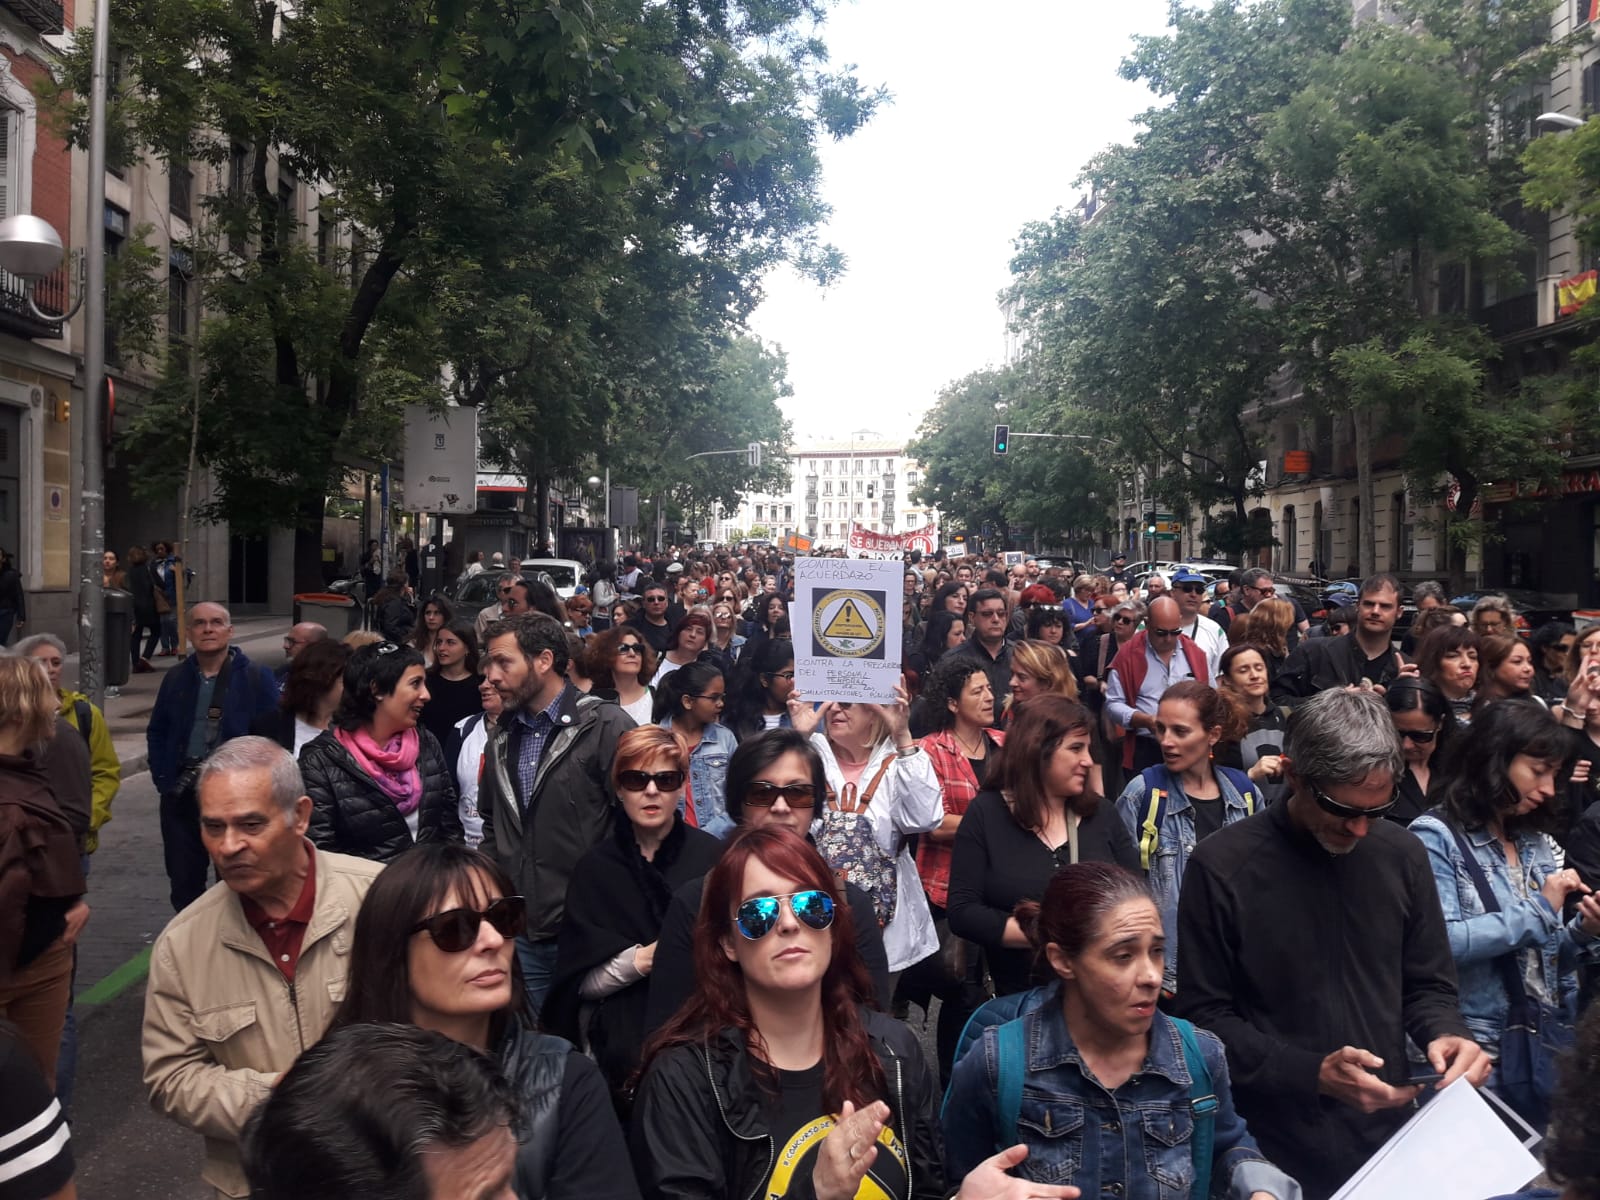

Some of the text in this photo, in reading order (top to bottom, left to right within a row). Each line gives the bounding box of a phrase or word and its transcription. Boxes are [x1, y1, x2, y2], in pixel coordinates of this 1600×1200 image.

[850, 535, 863, 548] SE
[798, 560, 893, 572] CONTRA EL
[800, 570, 874, 580] ACUERDAZO
[797, 659, 834, 667] CONTRA
[843, 660, 854, 668] LA
[799, 669, 870, 679] DEL PERSONAL
